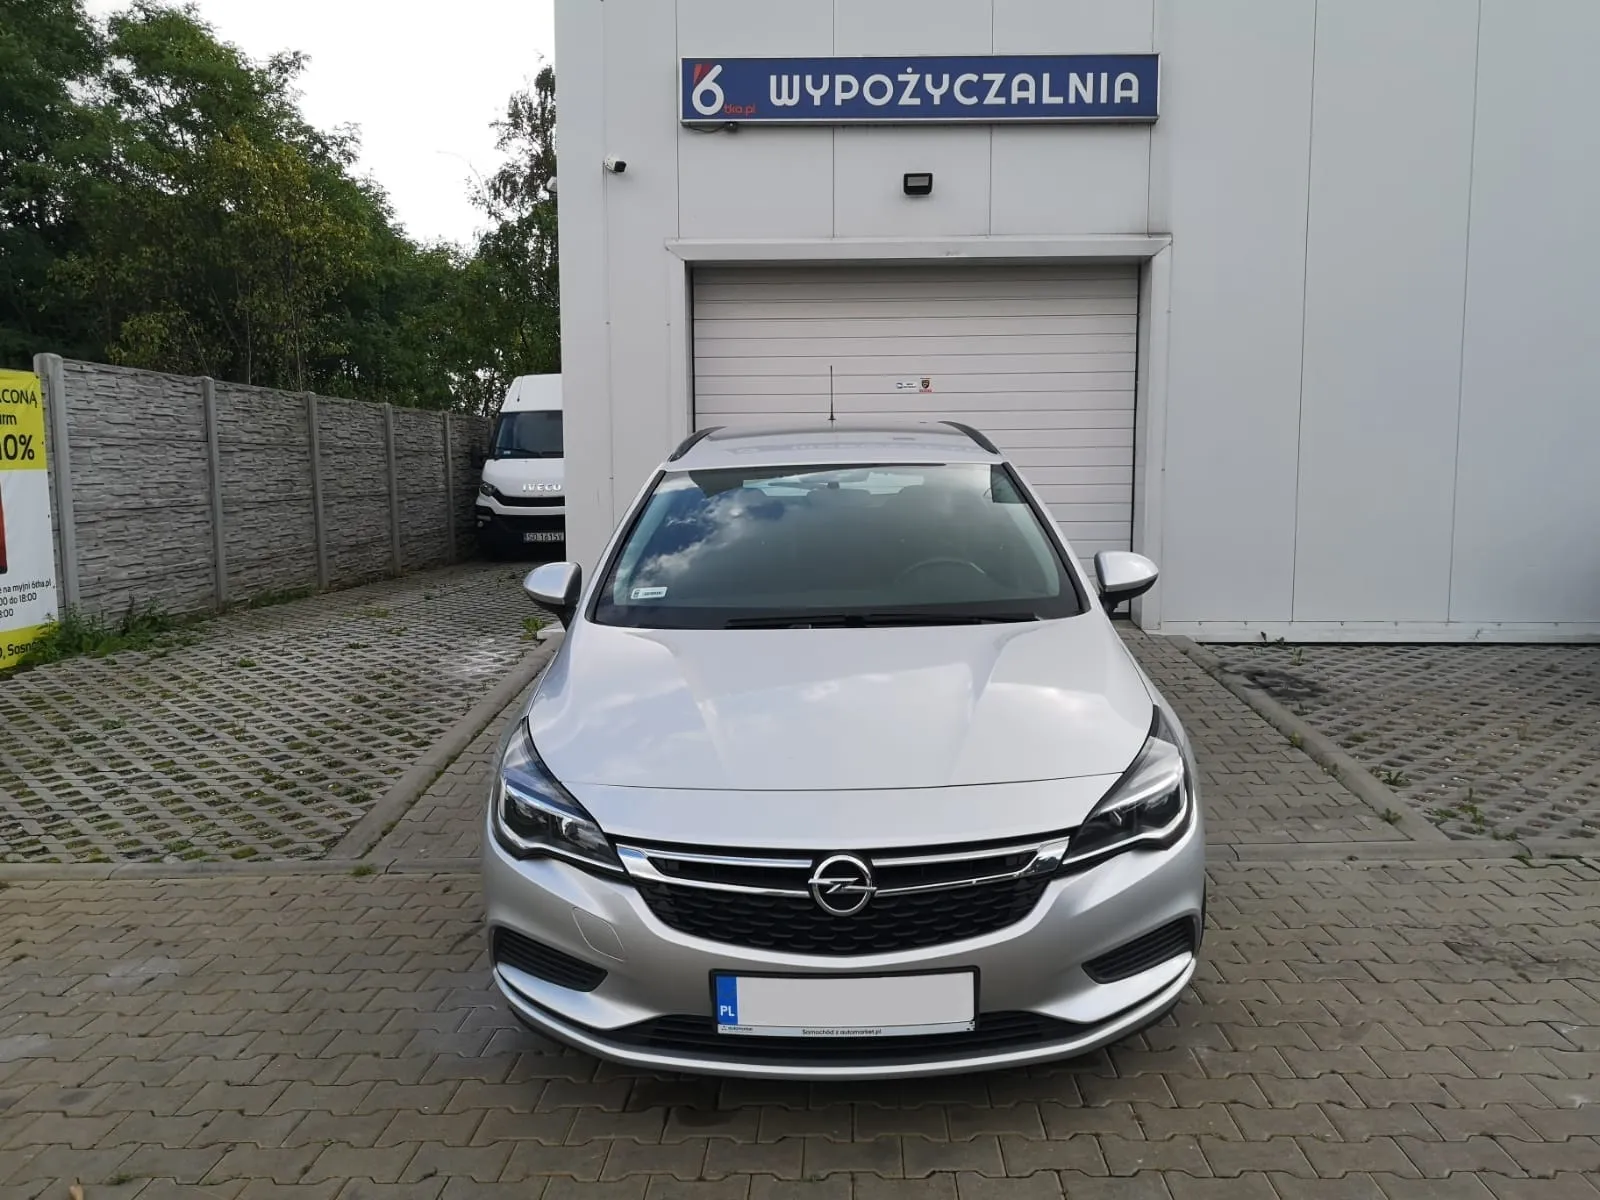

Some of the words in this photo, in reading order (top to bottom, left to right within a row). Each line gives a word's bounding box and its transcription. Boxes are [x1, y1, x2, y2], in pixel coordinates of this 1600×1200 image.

[769, 67, 1139, 106] WYPOŻYCZALNIA
[0, 389, 38, 408] CONĄ
[523, 483, 561, 492] IVECO
[12, 583, 31, 592] myjni
[9, 596, 18, 605] do
[19, 592, 37, 603] 18:00
[720, 1005, 735, 1016] PL
